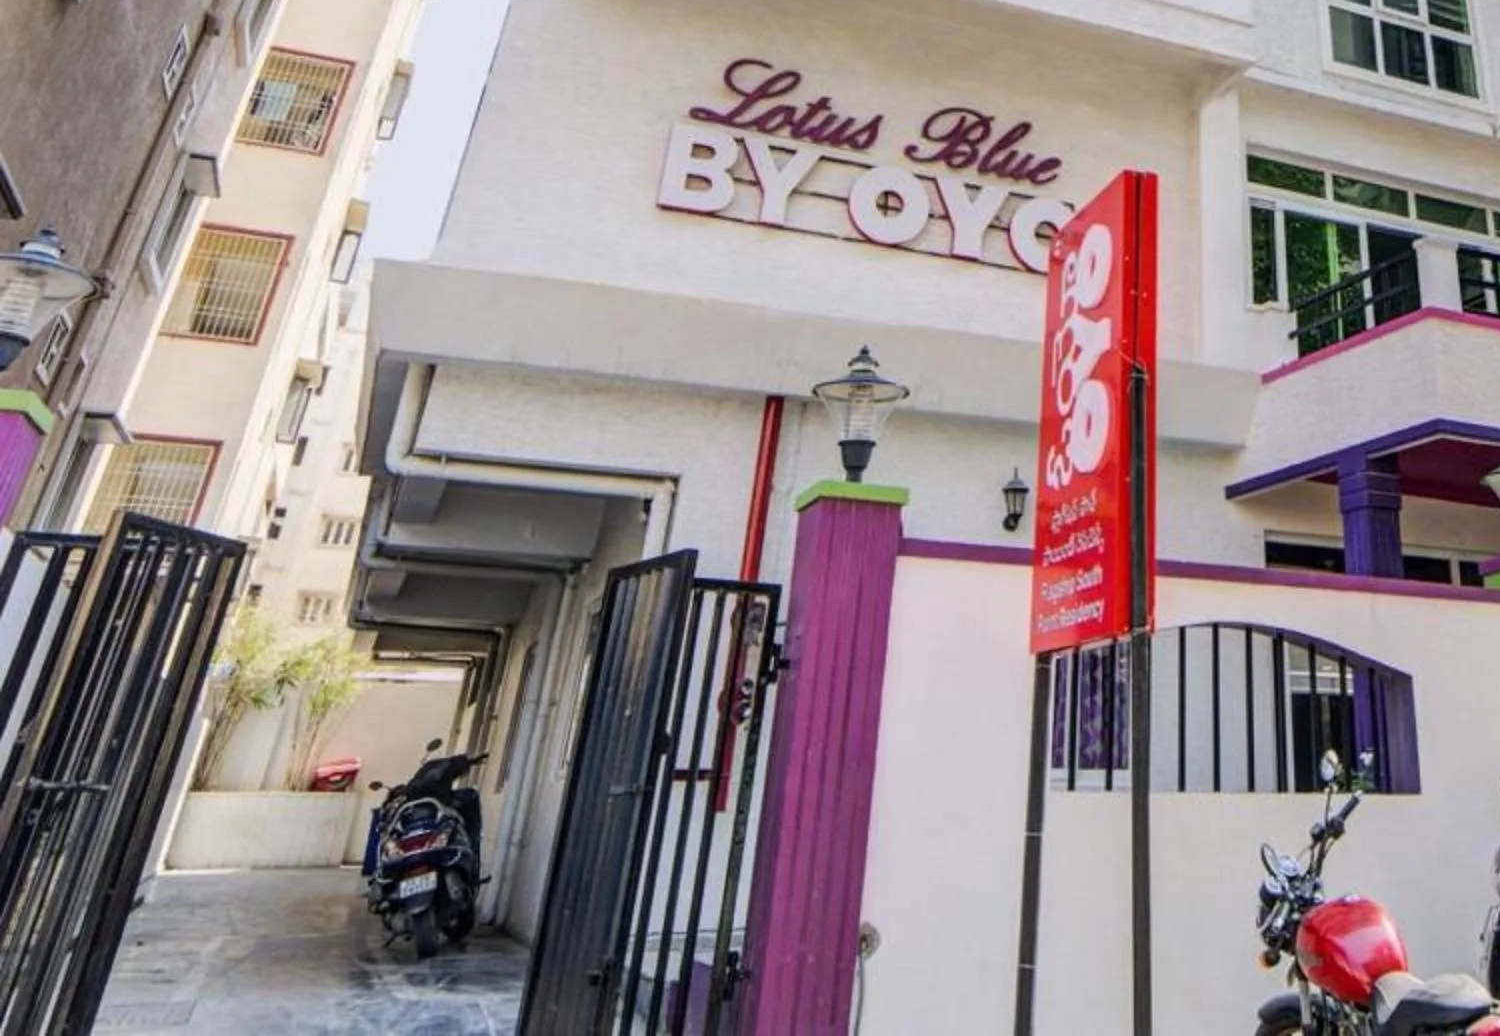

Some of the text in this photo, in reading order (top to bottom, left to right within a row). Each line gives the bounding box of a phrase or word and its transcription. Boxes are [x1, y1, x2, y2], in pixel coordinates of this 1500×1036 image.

[689, 58, 1064, 186] Lotus Blue
[656, 123, 1076, 274] BY OYO
[1066, 223, 1113, 474] OYO
